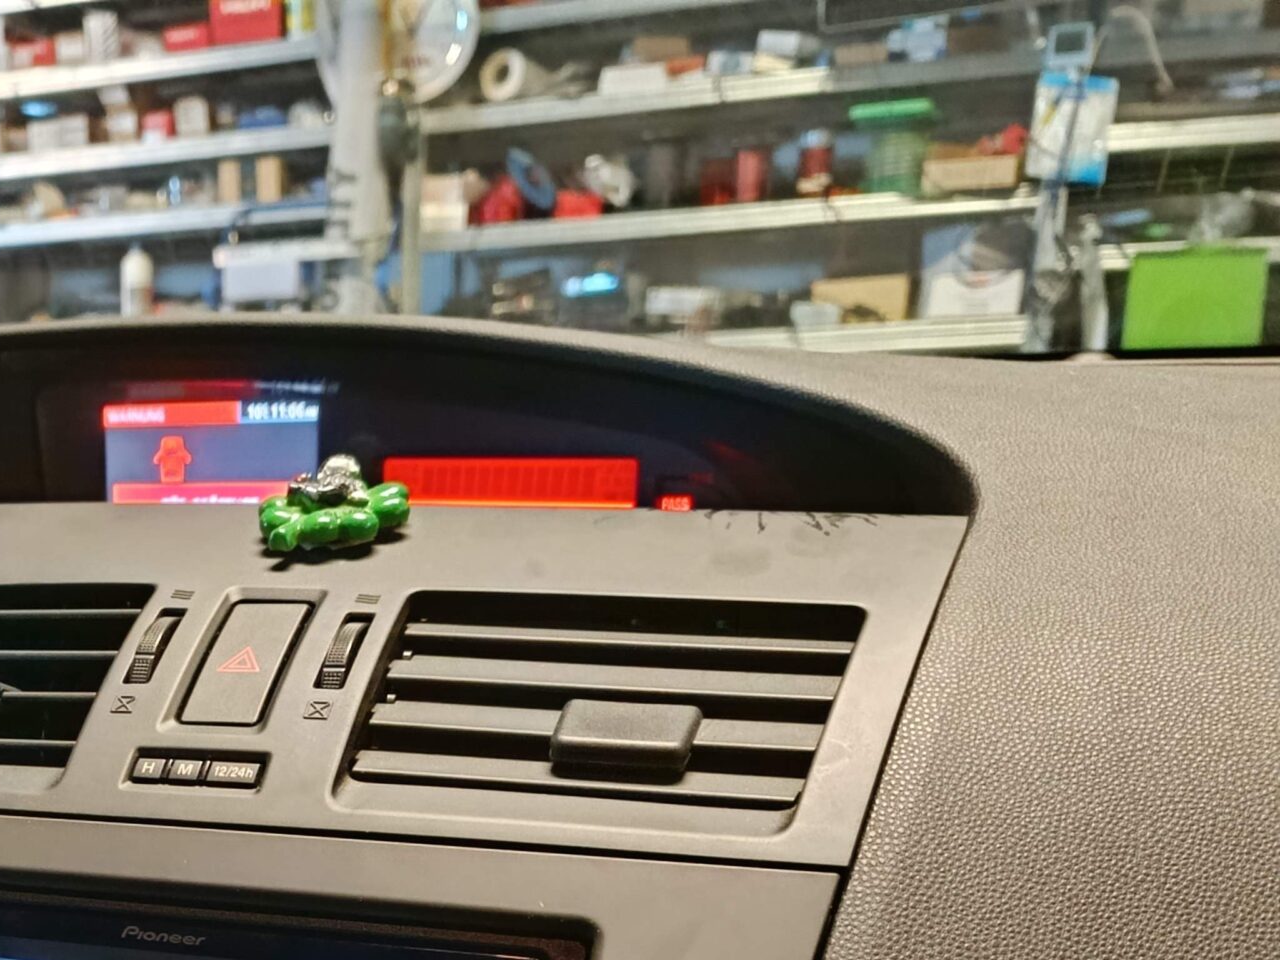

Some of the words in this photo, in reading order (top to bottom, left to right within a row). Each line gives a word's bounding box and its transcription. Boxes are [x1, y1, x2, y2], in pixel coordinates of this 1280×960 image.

[140, 761, 157, 774] H
[176, 763, 193, 776] M
[213, 765, 254, 779] 12/24h
[121, 925, 207, 946] Pioneer
